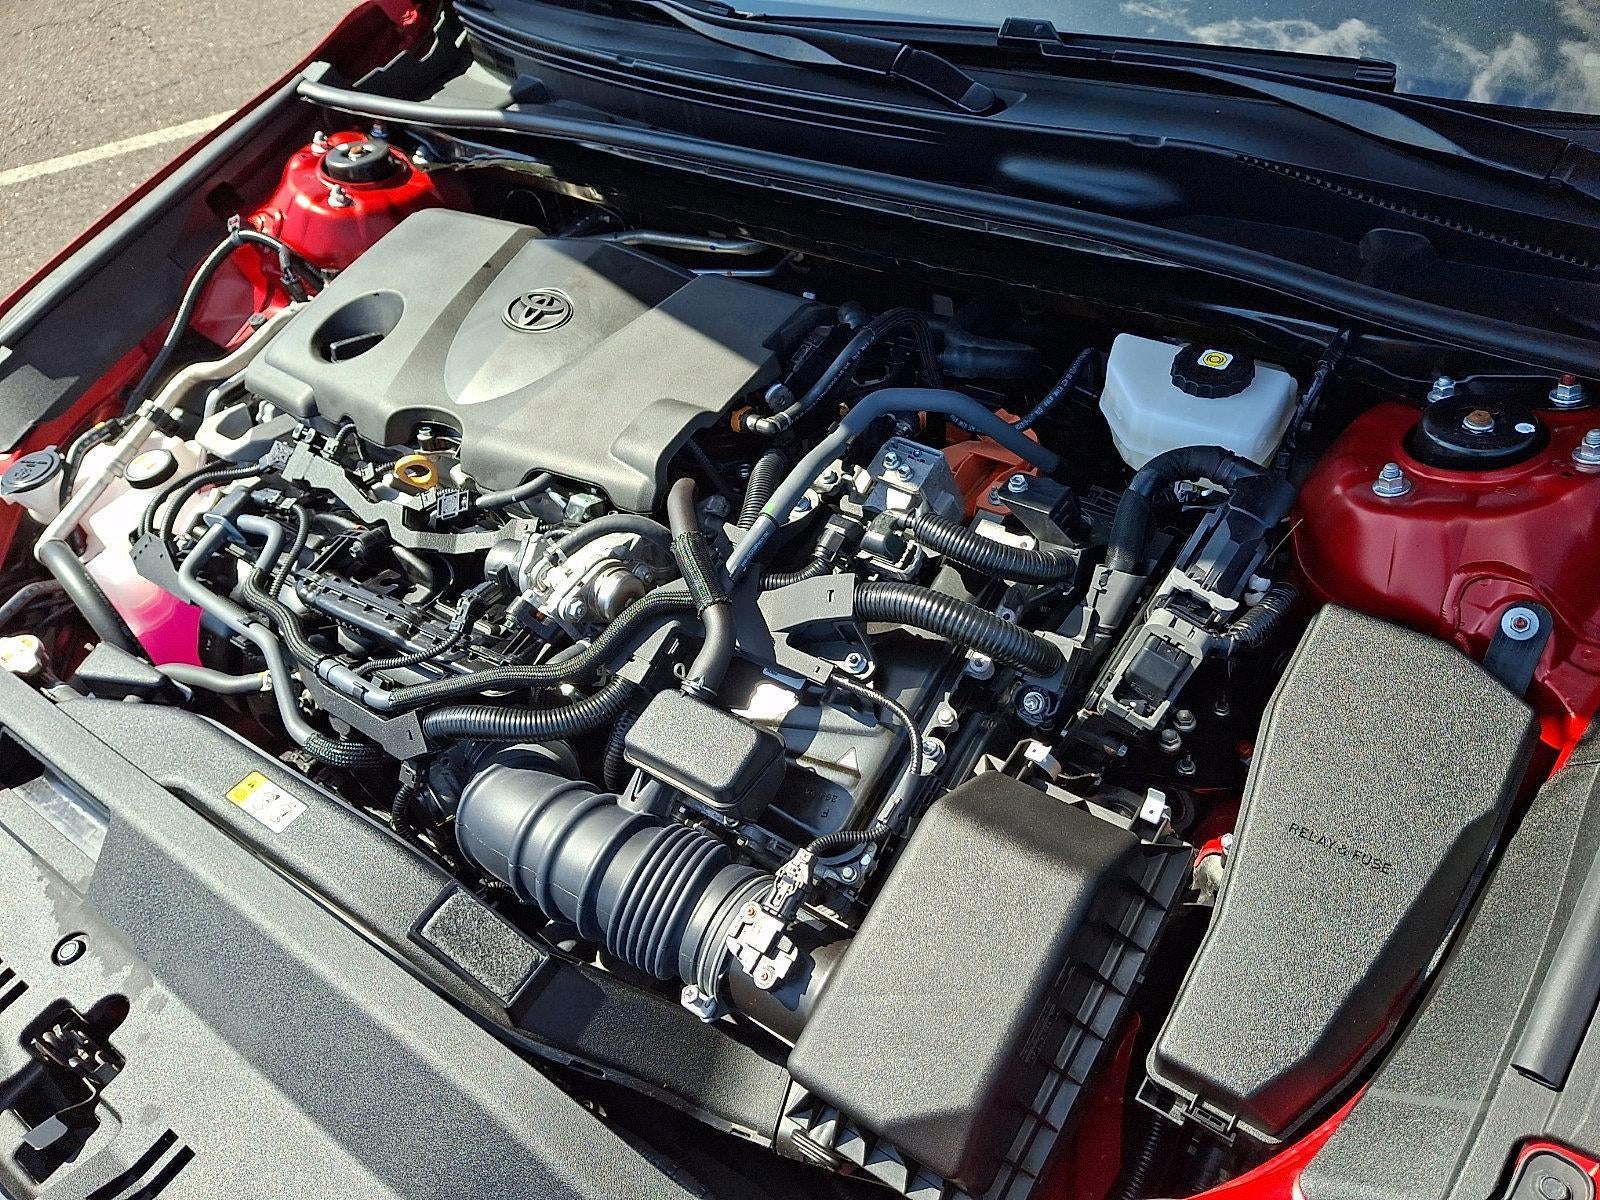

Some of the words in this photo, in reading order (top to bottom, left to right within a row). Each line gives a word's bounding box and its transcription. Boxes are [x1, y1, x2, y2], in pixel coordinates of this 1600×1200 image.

[1288, 822, 1338, 850] RELAY
[1337, 843, 1348, 856] &
[1350, 849, 1393, 875] FUSE
